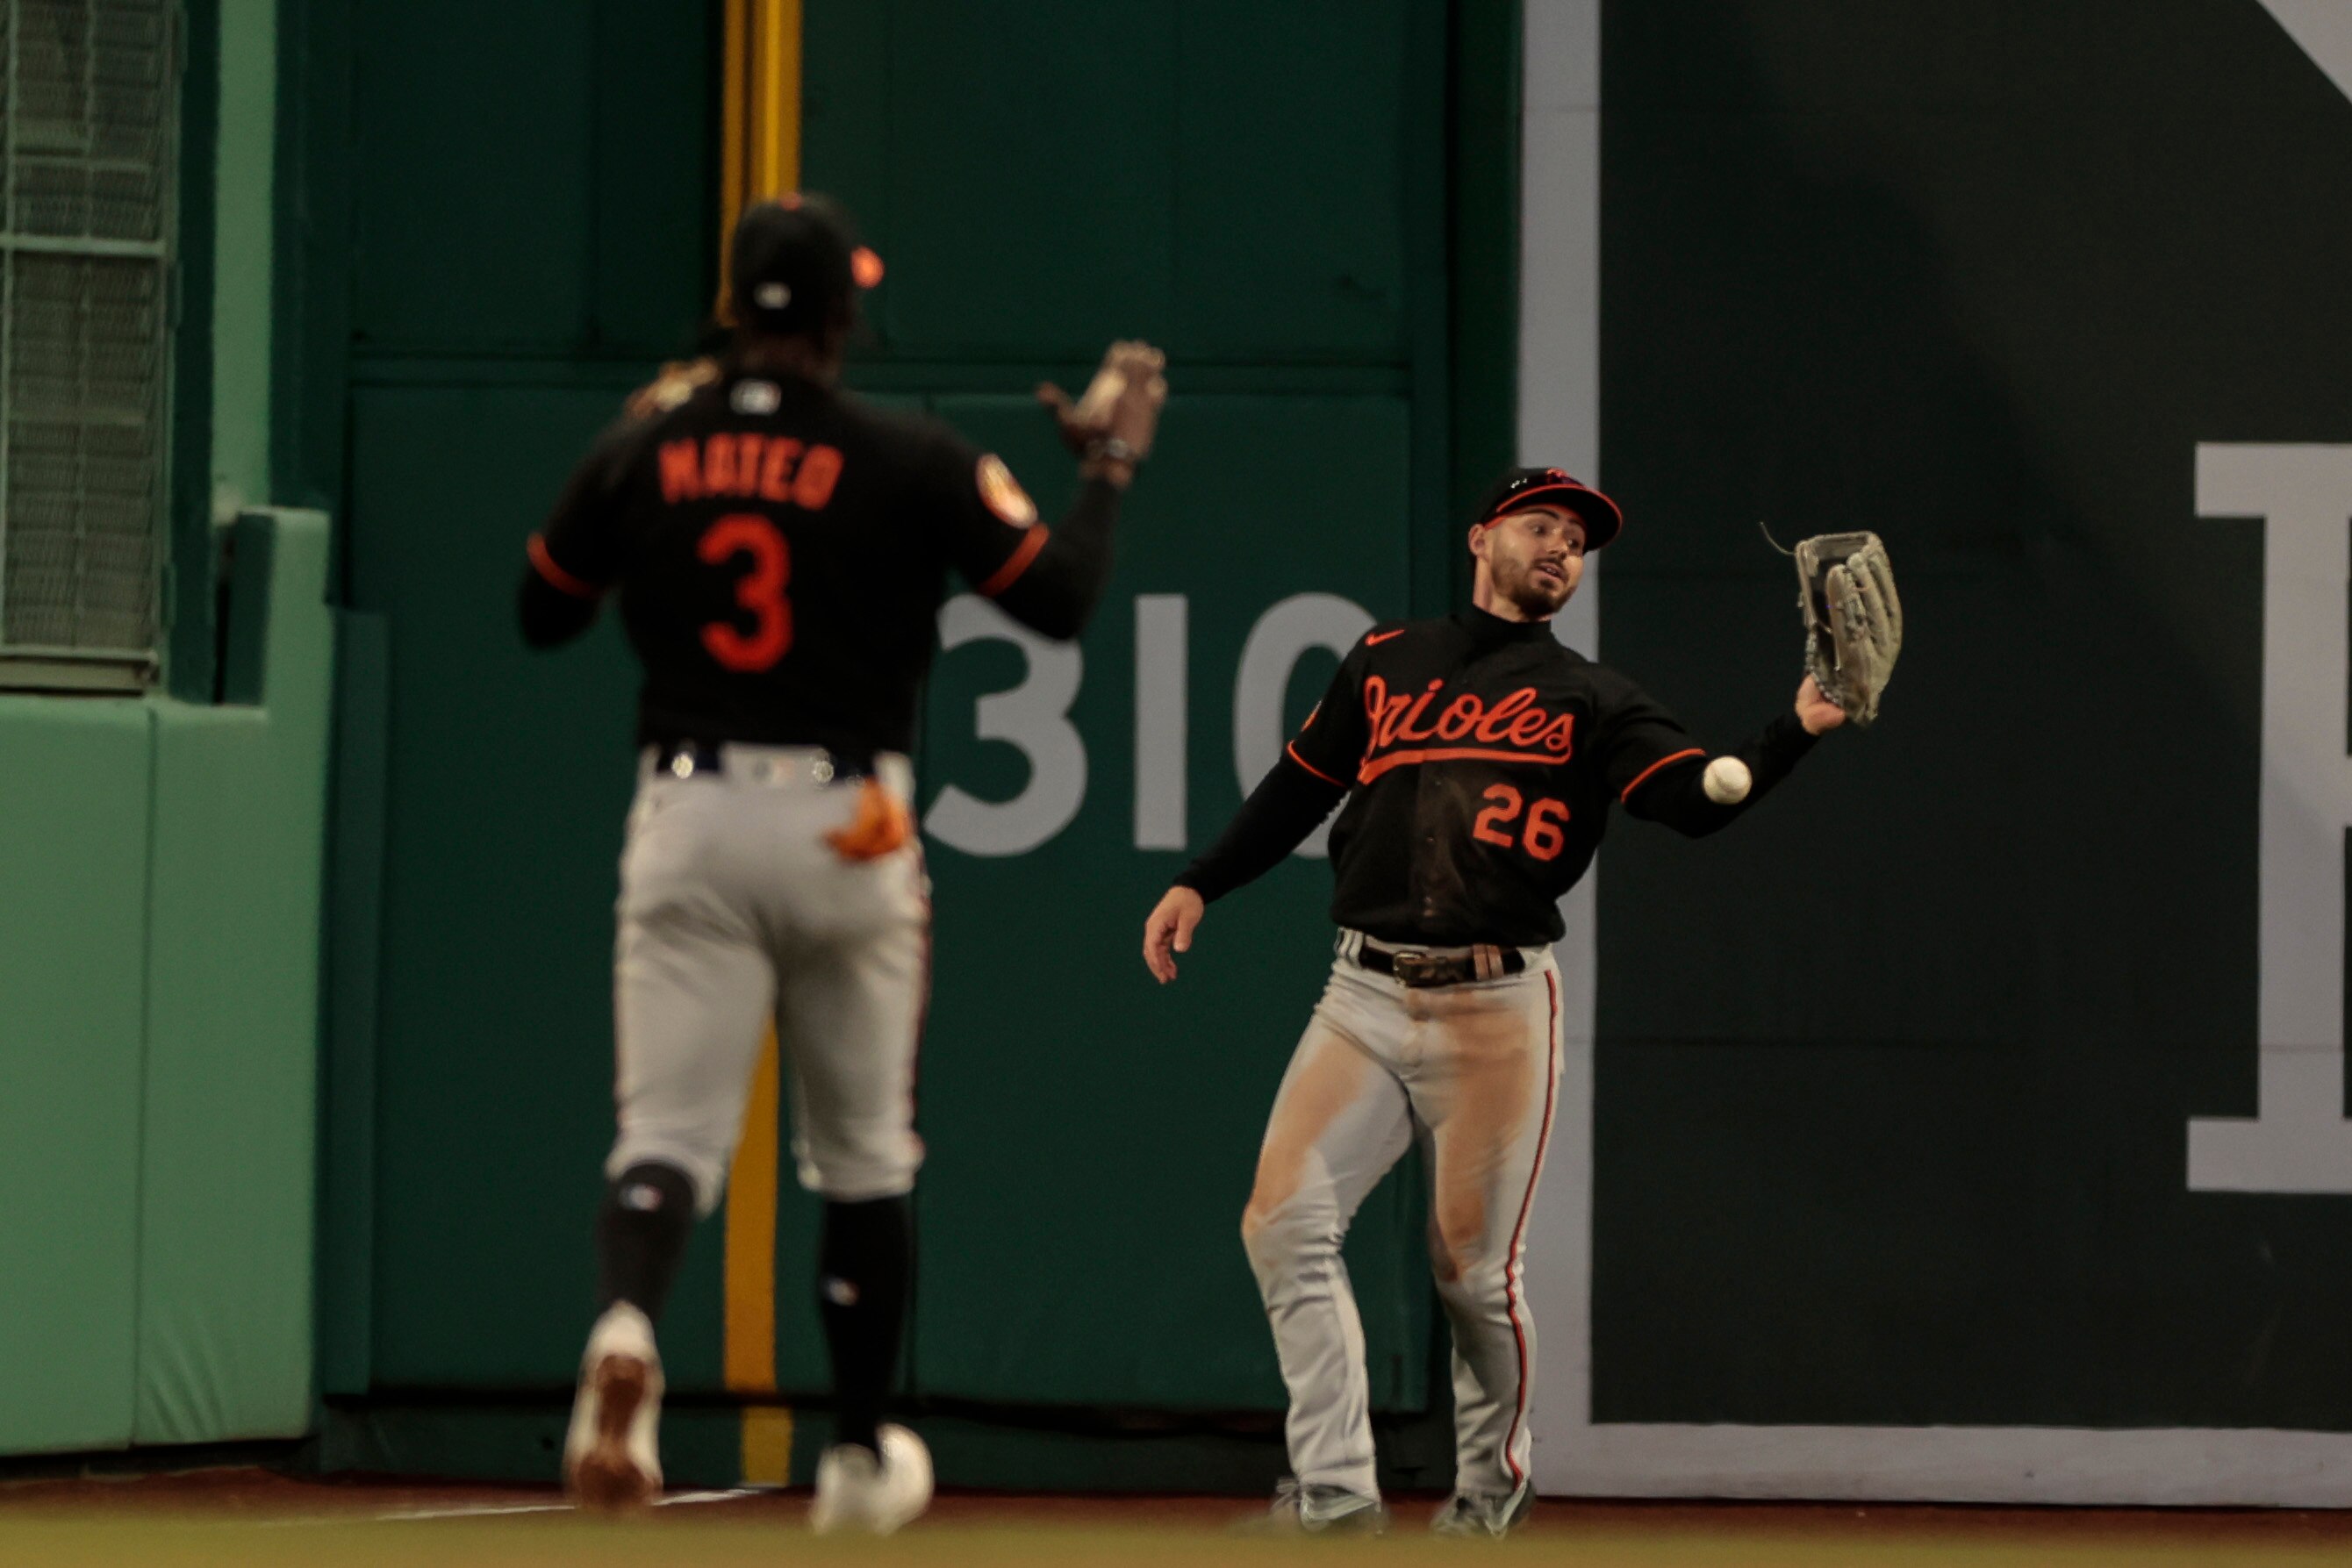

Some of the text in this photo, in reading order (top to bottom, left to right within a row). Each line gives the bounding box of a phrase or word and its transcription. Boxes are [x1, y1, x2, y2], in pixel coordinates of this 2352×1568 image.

[657, 431, 847, 512] MATEO
[694, 512, 795, 674] 3
[1473, 783, 1572, 863] 26
